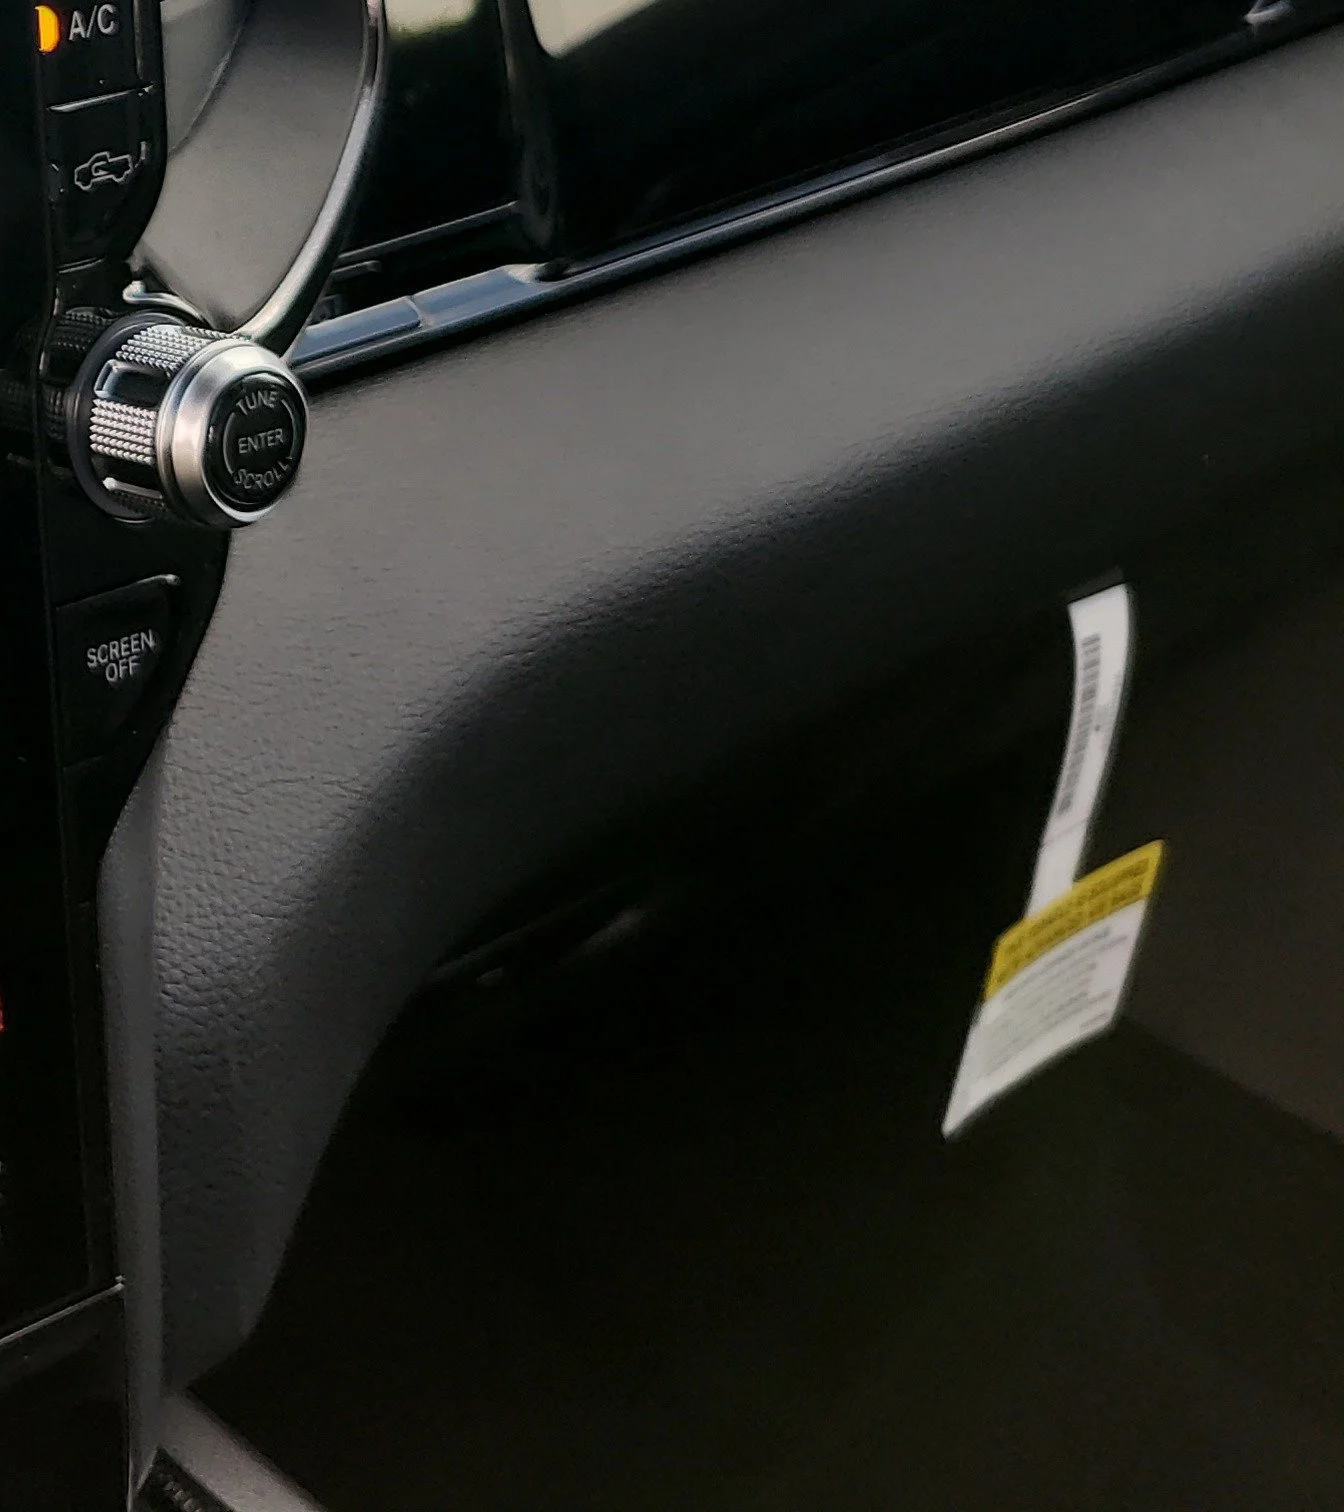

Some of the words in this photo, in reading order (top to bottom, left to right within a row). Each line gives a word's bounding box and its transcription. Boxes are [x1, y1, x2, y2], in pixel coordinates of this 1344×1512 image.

[68, 3, 118, 42] A/C
[235, 390, 279, 416] TUNE
[237, 428, 285, 455] ENTER
[86, 629, 156, 670] SCREEN
[105, 658, 141, 684] OFF
